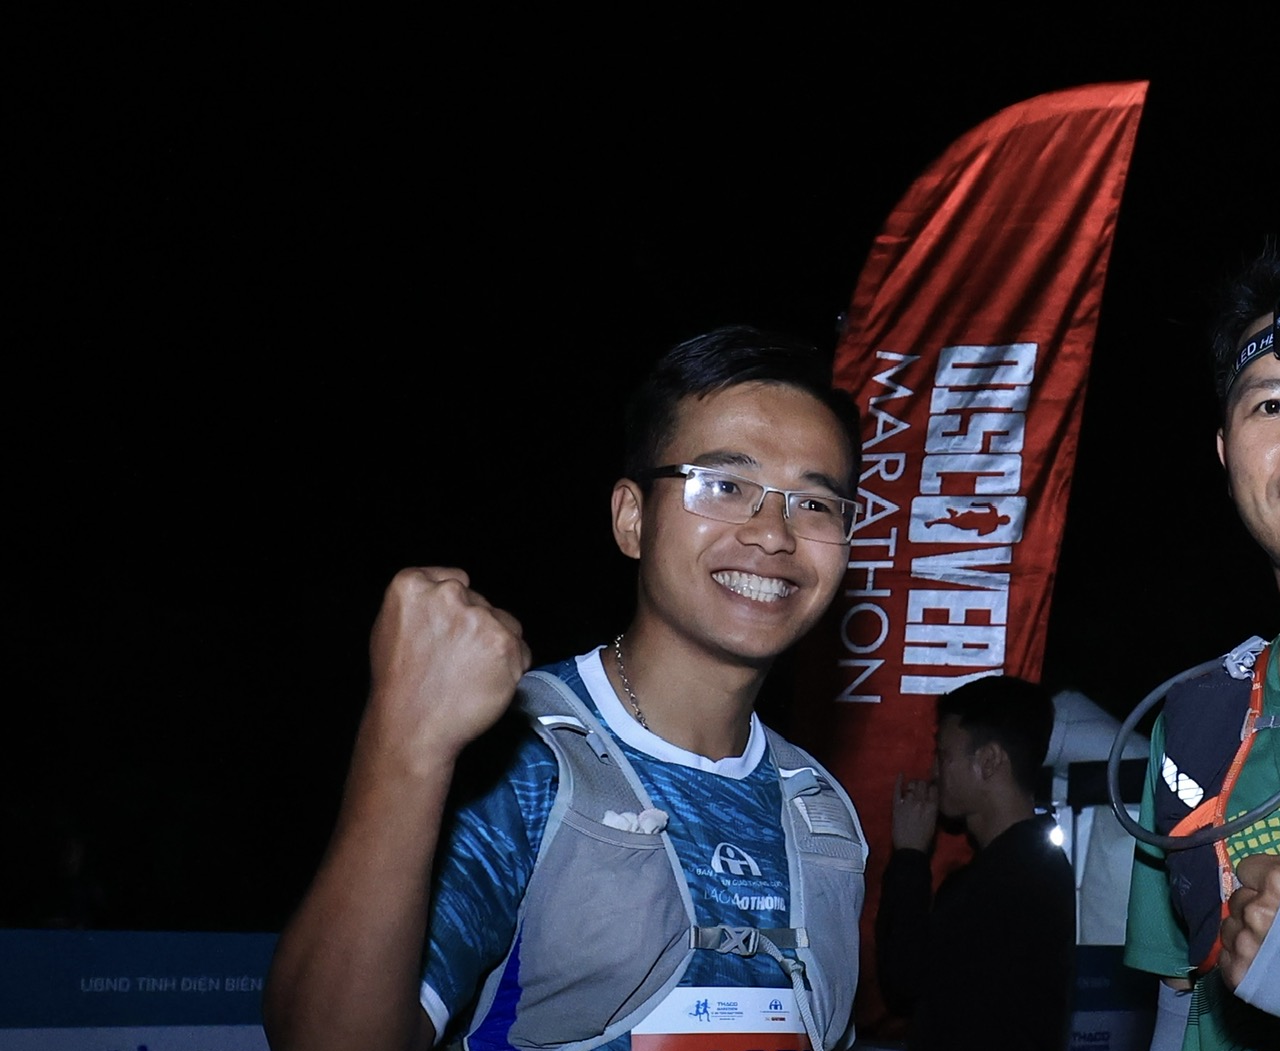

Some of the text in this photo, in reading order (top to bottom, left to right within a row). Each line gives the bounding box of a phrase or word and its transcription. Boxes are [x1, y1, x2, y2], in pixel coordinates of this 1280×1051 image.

[1235, 341, 1257, 370] LED
[835, 350, 922, 704] MARATHON
[79, 976, 131, 993] UBND
